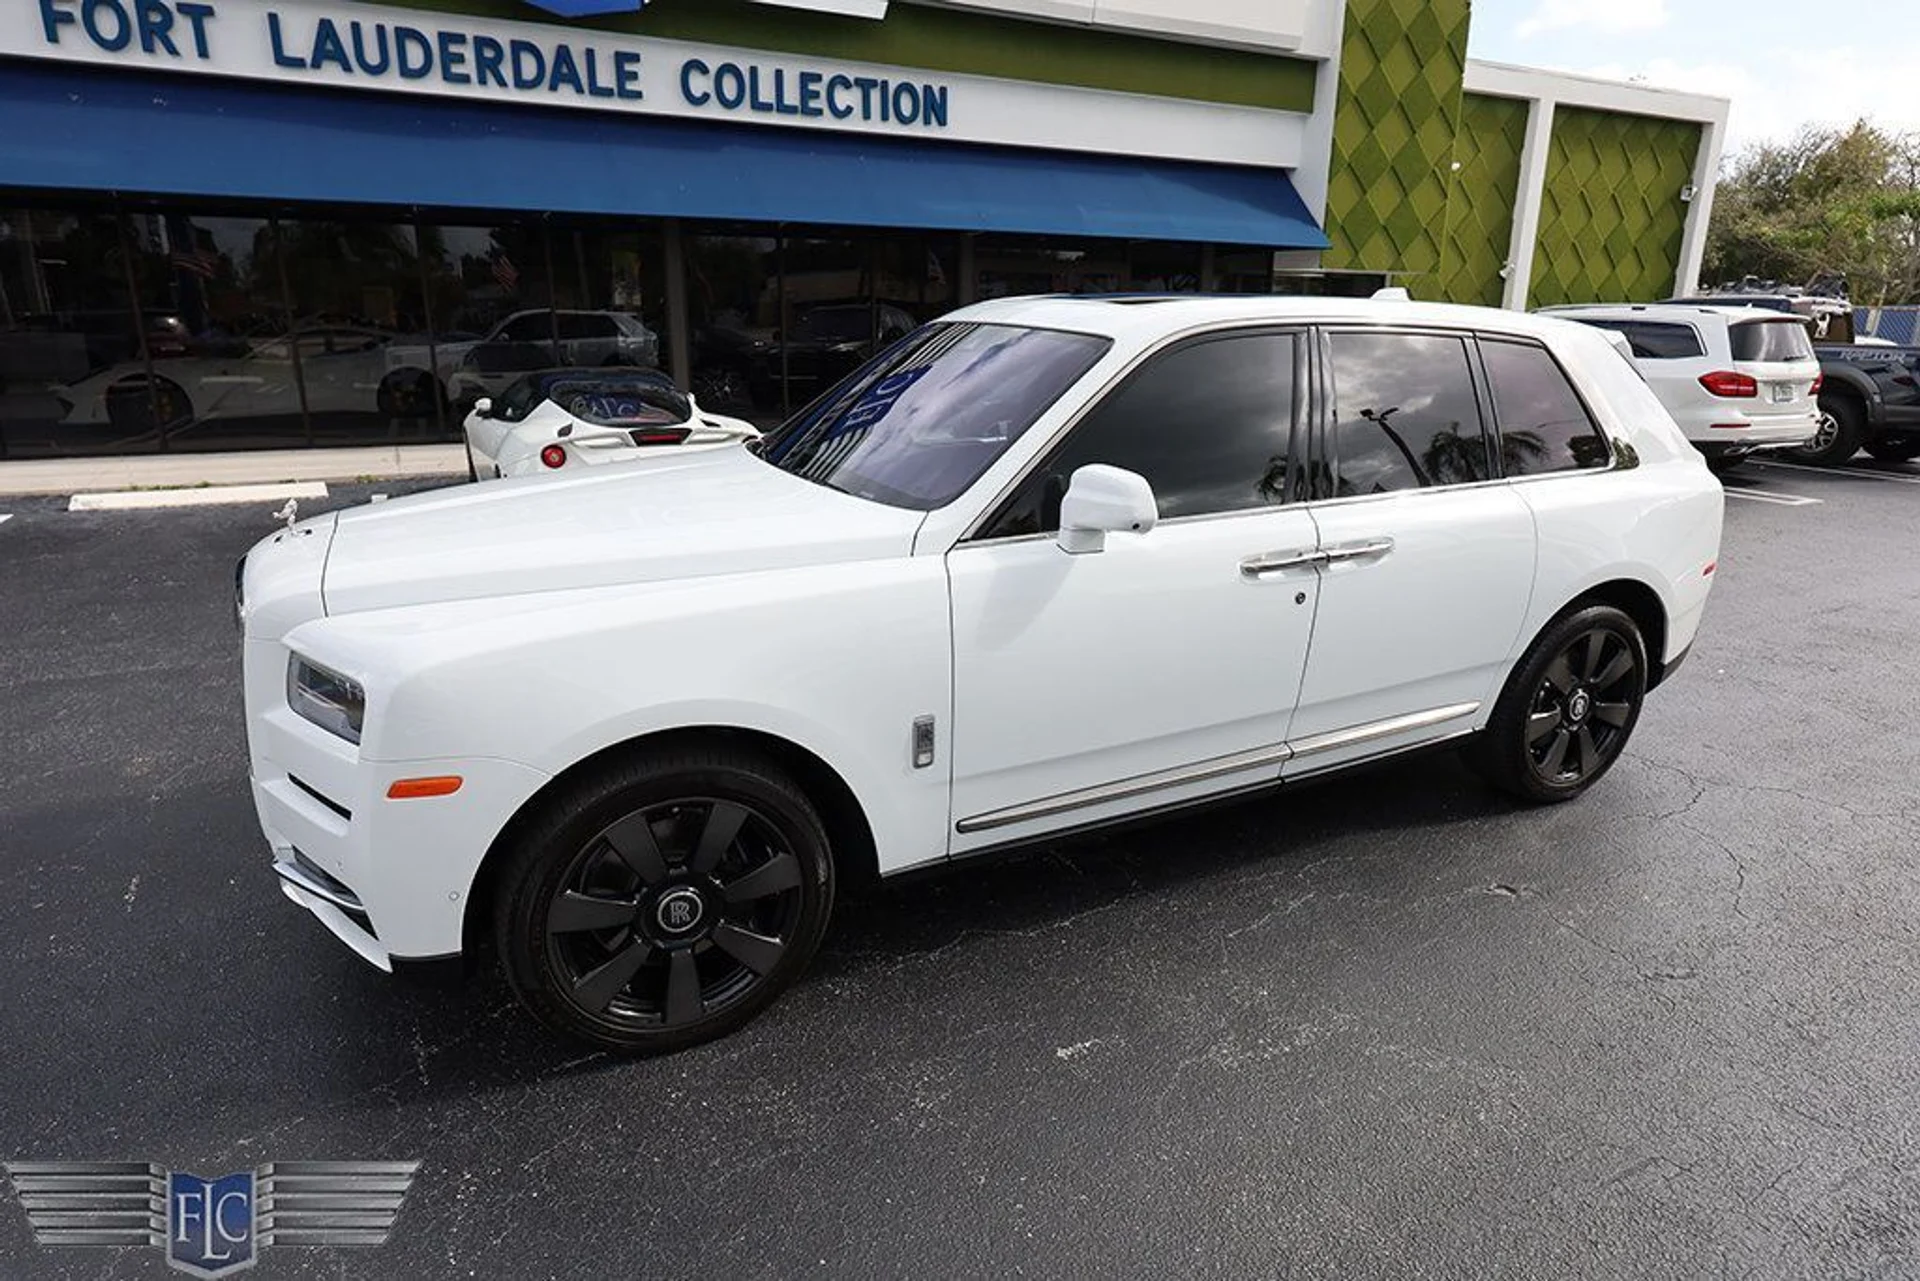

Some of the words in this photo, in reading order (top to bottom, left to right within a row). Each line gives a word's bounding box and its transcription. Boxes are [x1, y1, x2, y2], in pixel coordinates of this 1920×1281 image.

[40, 0, 214, 60] FORT
[267, 12, 643, 100] LAUDERDALE
[680, 59, 949, 127] COLLECTION
